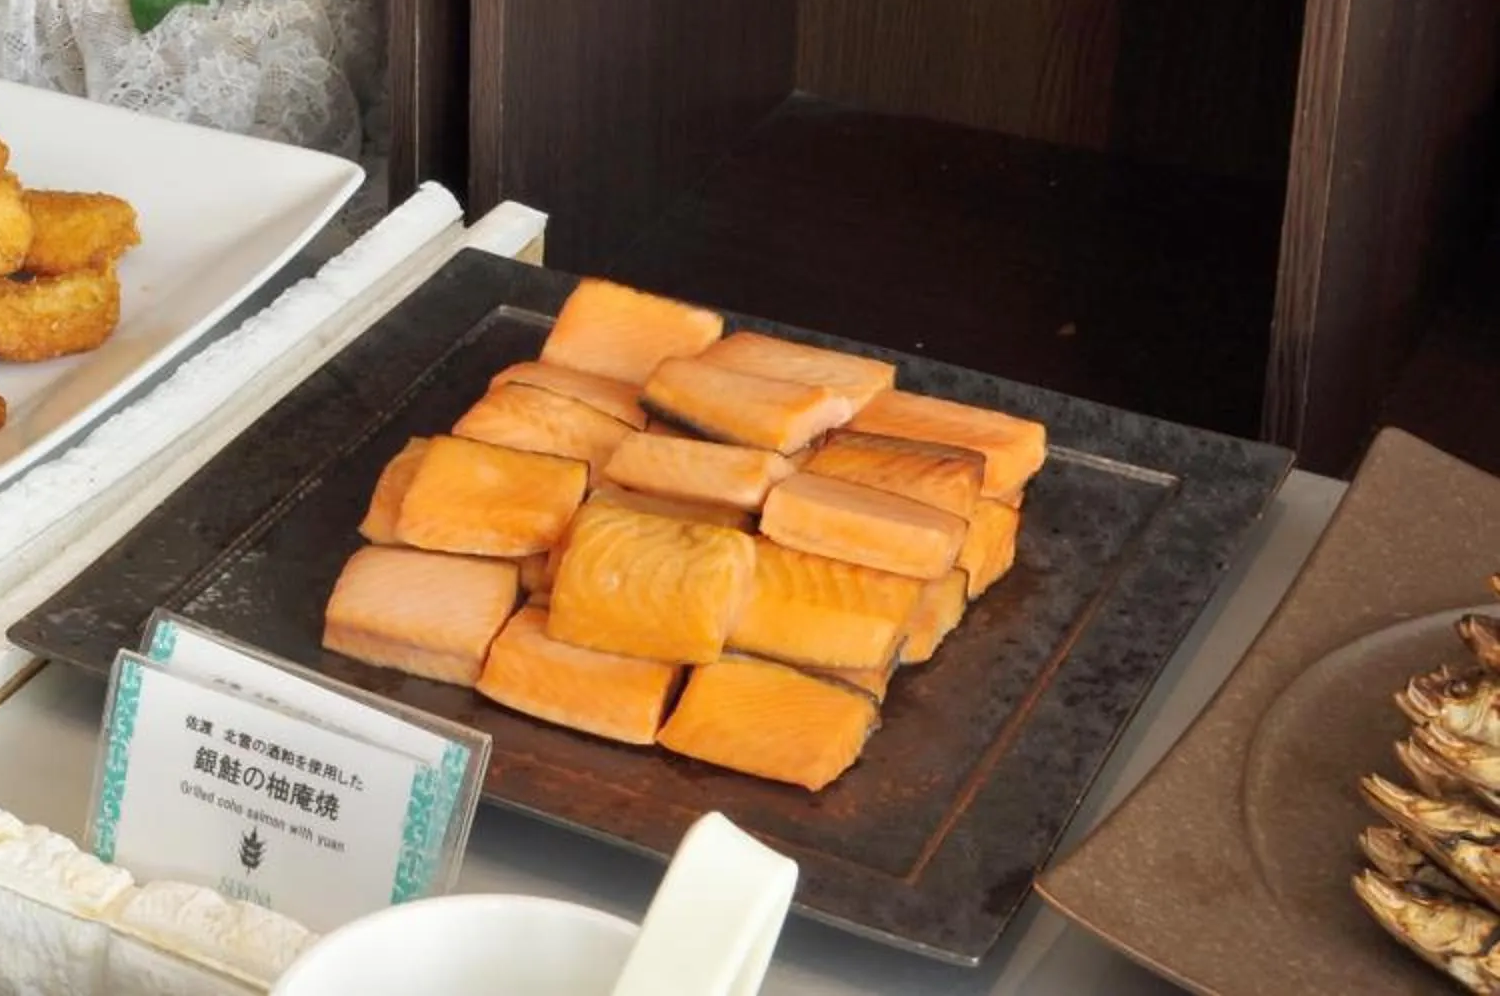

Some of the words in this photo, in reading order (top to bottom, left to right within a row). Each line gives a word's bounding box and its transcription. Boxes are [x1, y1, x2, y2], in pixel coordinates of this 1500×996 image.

[180, 779, 215, 804] Grilled
[247, 806, 286, 832] salmon
[289, 823, 313, 843] with
[193, 745, 341, 821] 銀鮭の柚庵焼
